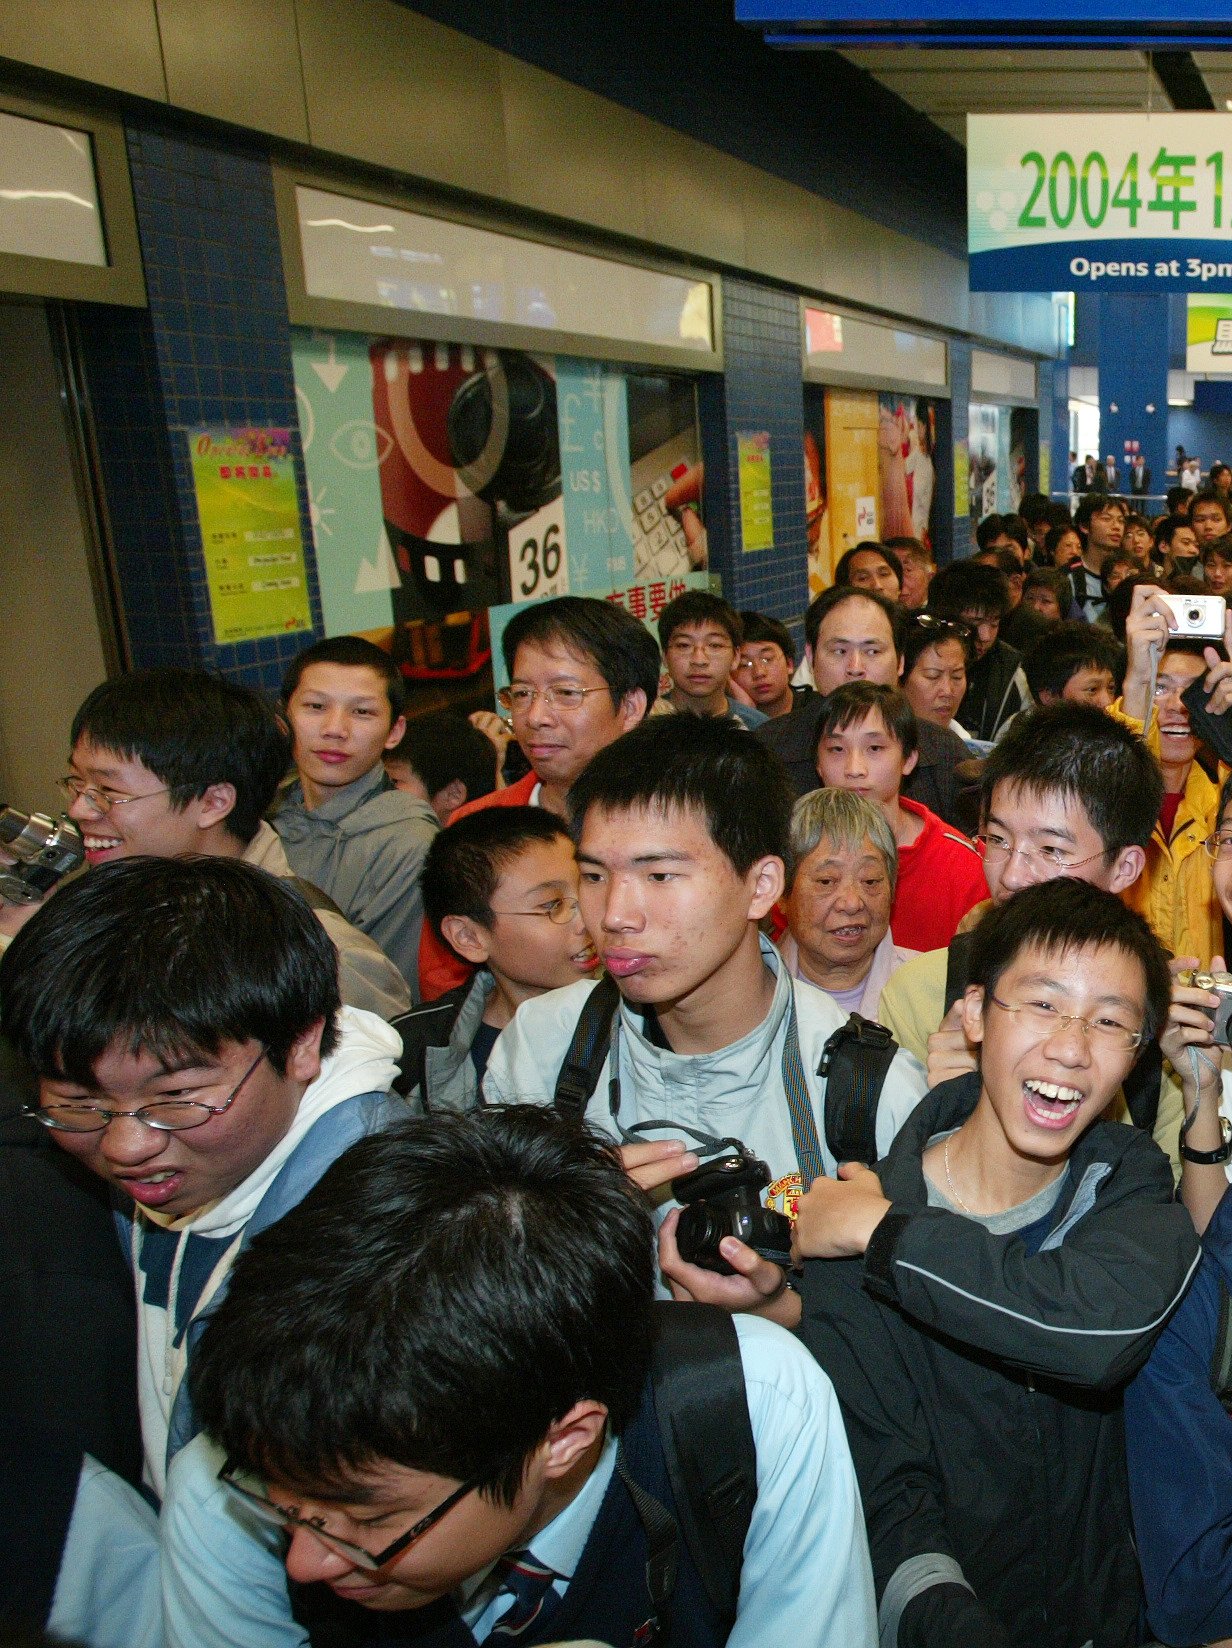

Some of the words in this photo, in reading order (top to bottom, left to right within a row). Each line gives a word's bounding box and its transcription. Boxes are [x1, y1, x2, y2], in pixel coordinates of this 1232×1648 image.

[1069, 257, 1149, 281] Opens
[1154, 259, 1181, 277] at
[519, 524, 562, 597] 36
